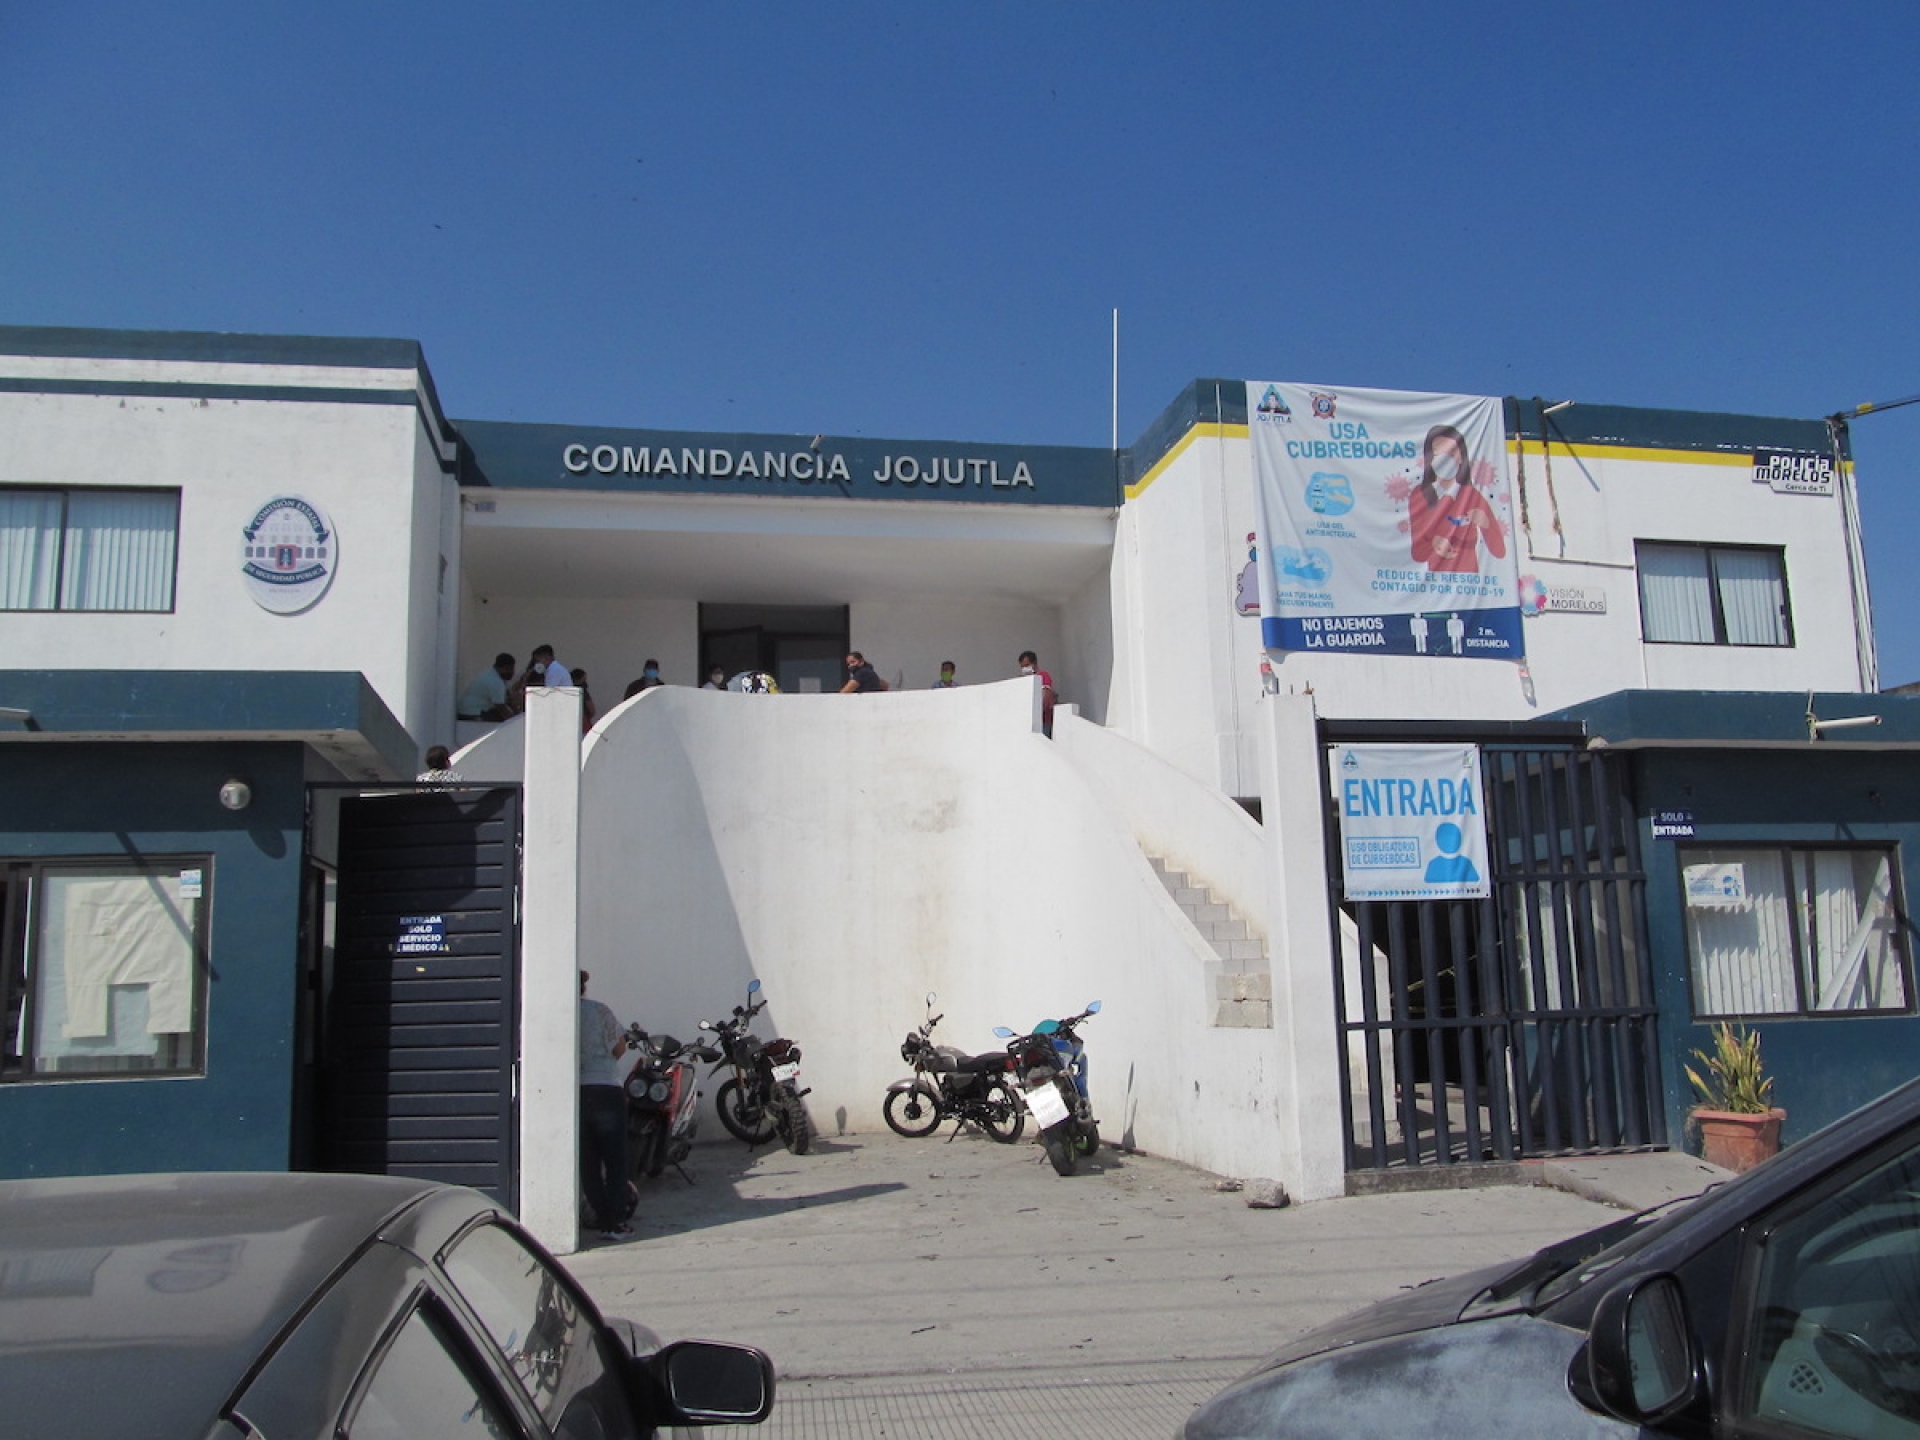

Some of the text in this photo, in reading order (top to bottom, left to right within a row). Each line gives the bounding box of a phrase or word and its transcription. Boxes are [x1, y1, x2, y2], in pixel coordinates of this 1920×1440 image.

[1330, 422, 1370, 440] USA
[1287, 440, 1417, 459] CUBREBOCAS
[562, 443, 1036, 487] COMANDANCIA JOJUTLA
[1756, 467, 1830, 484] MORELOS
[1785, 484, 1807, 492] Cerca
[1808, 484, 1818, 492] de
[1305, 529, 1357, 538] ANTIBACTERIAL
[1377, 569, 1499, 585] REDUCE EL RIESGO DE
[1371, 580, 1505, 597] CONTAGIO POR COVID-19
[1551, 599, 1604, 610] MORELOS
[1301, 617, 1385, 631] NO BAJEMOS
[1478, 627, 1484, 635] 2
[1305, 632, 1386, 647] LA GUARDIA
[1466, 638, 1509, 649] DISTANCIA
[1343, 778, 1477, 817] ENTRADA
[1660, 812, 1684, 822] SOLO
[1654, 825, 1694, 836] ENTRADA
[1350, 841, 1415, 852] USO OBLIGATORIO
[1351, 853, 1415, 864] DE CUBREBOCAS
[399, 916, 443, 924] ENTRADA
[399, 935, 441, 943] SERVICIO
